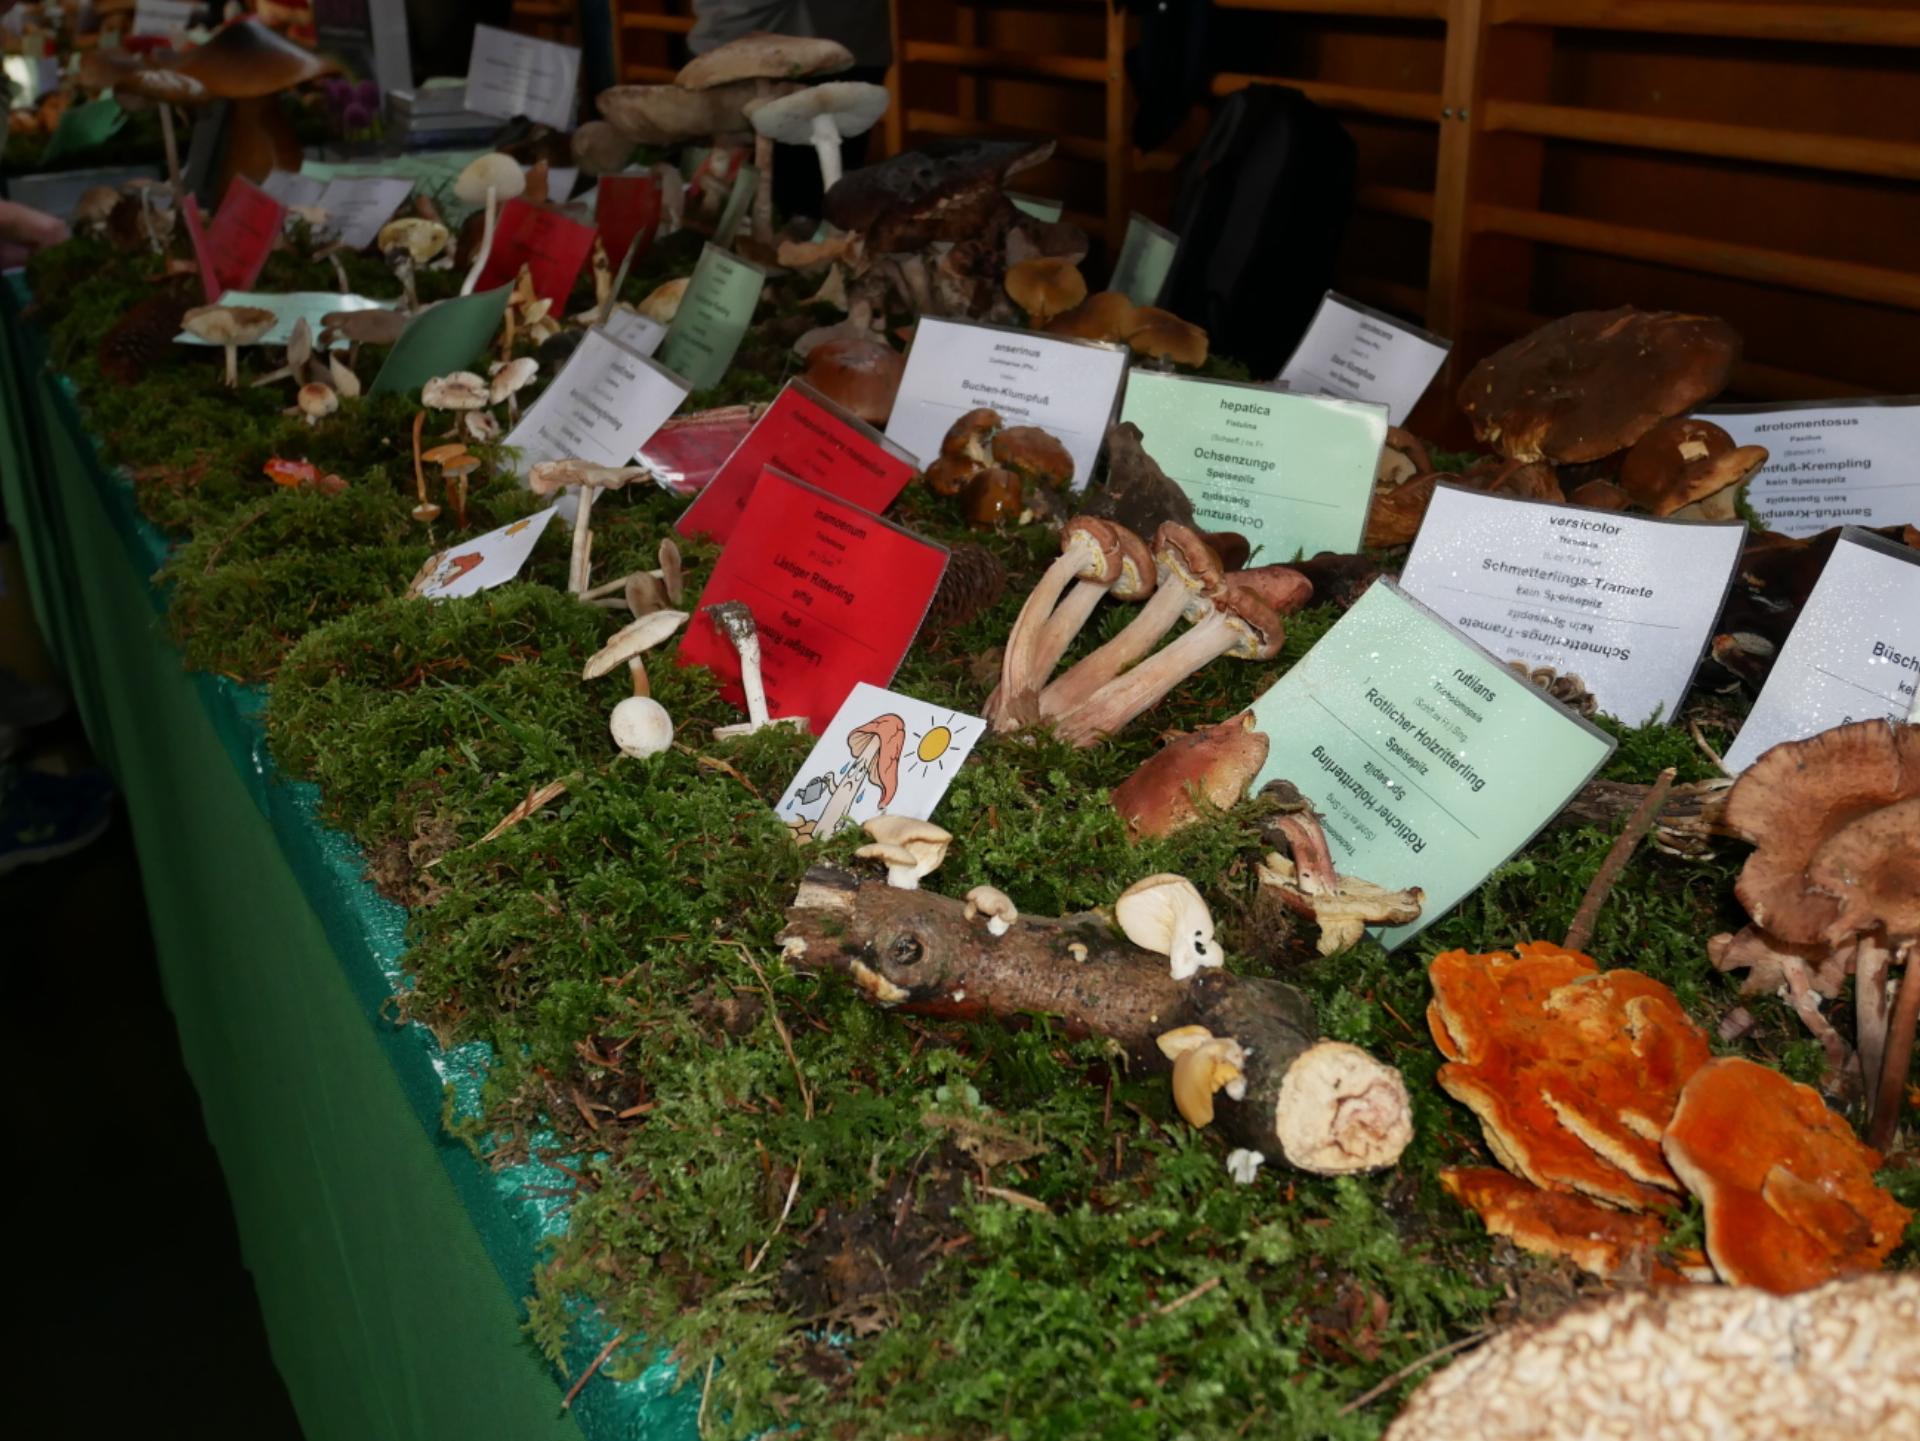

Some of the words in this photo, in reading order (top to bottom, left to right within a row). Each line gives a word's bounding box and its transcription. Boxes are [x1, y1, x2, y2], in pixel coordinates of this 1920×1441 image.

[994, 342, 1041, 359] anserinus
[961, 379, 1049, 406] Buchen-Klumpfuß
[1219, 398, 1271, 417] hepatica
[1754, 417, 1859, 433] atrotomentosus
[1194, 446, 1276, 471] Ochsenzunge
[1758, 457, 1872, 474] mtfuß-Krempling
[1206, 467, 1256, 485] Speisepilz
[1765, 478, 1788, 487] kein
[1791, 475, 1847, 487] Speisepilz
[1201, 490, 1251, 508] Speisepilz
[1765, 494, 1821, 505] Speisepilz
[1549, 515, 1623, 536] versicolor
[810, 570, 856, 606] Ritterling
[1481, 557, 1655, 600] Schmetterlings-Tramete
[1515, 585, 1541, 598] kein
[1543, 589, 1604, 610] Speisepilz
[1506, 608, 1567, 630] Speisepilz
[1569, 622, 1595, 636] kein
[1458, 616, 1632, 662] Schmetterlings-Tramete
[1871, 640, 1920, 674] Büsch
[1452, 667, 1497, 703] rutilans
[1897, 680, 1917, 697] kei
[1364, 687, 1417, 735] Rötlicher
[1414, 727, 1487, 793] Holzritterling
[1385, 735, 1430, 777] Speisepilz
[1311, 745, 1378, 811] Holzritterling
[1375, 803, 1428, 855] Rötlicher
